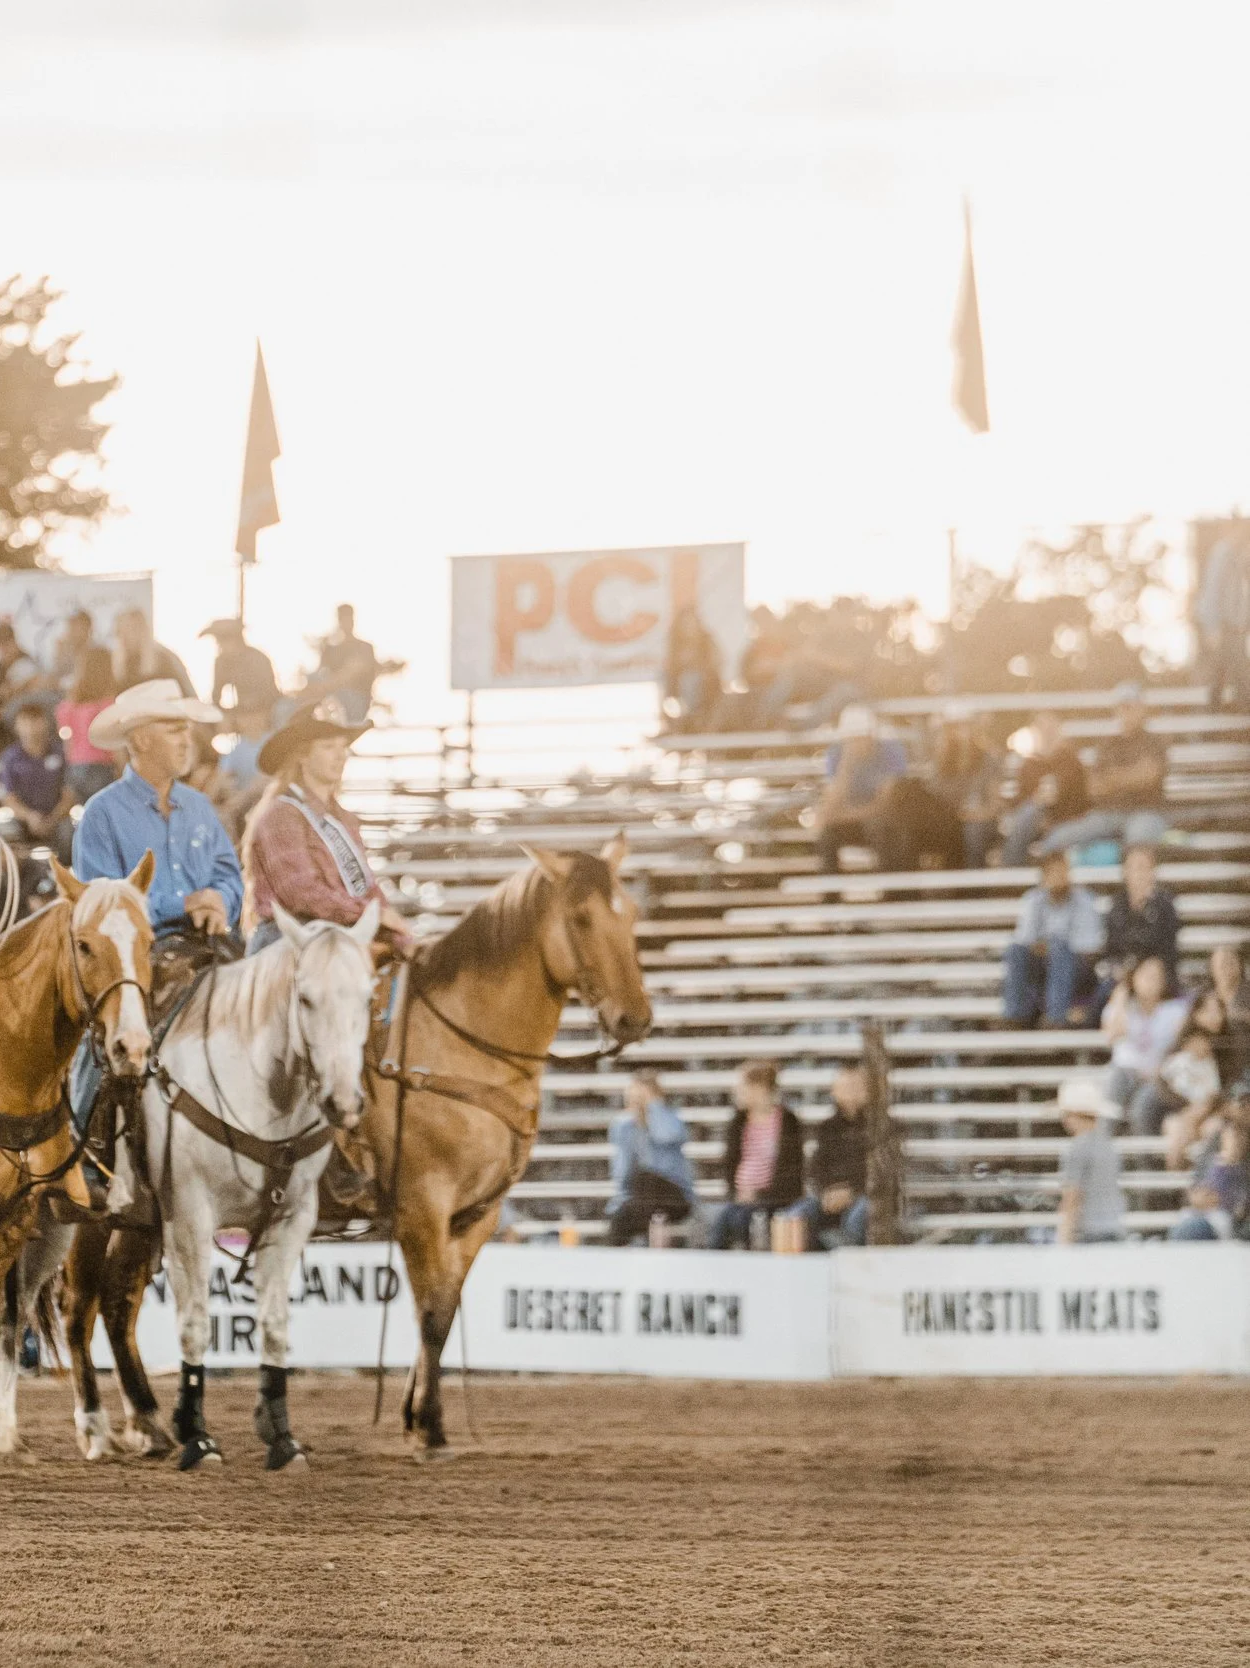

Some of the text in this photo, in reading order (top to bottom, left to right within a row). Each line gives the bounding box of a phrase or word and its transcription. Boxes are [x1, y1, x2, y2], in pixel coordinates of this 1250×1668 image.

[505, 1288, 743, 1335] DESERET RANCH
[1058, 1289, 1161, 1332] MEATS
